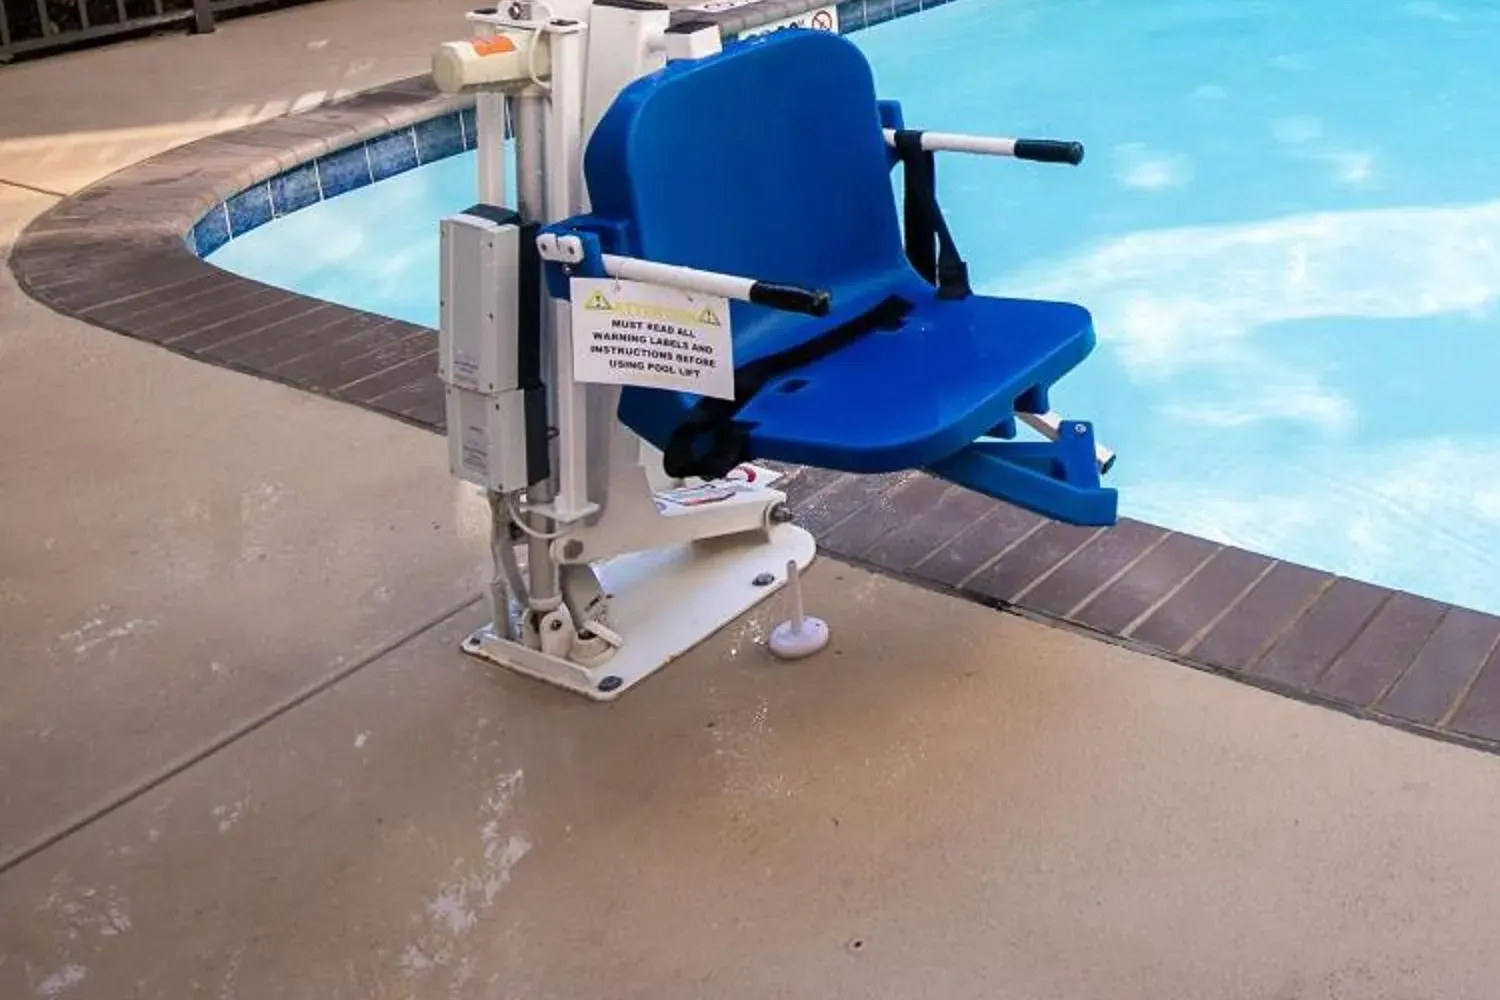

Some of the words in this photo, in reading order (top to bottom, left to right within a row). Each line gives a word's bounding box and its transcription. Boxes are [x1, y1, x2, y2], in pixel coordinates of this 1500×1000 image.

[611, 319, 643, 330] MUST
[646, 321, 675, 334] READ
[677, 327, 696, 338] ALL
[592, 331, 647, 345] WARNING
[650, 336, 689, 350] LABELS
[692, 342, 713, 354] AND
[590, 345, 673, 361] INSTRUCTIONS
[675, 353, 716, 368] BEFORE
[609, 359, 645, 370] USING
[647, 363, 676, 375] POOL
[679, 367, 701, 378] LIFT
